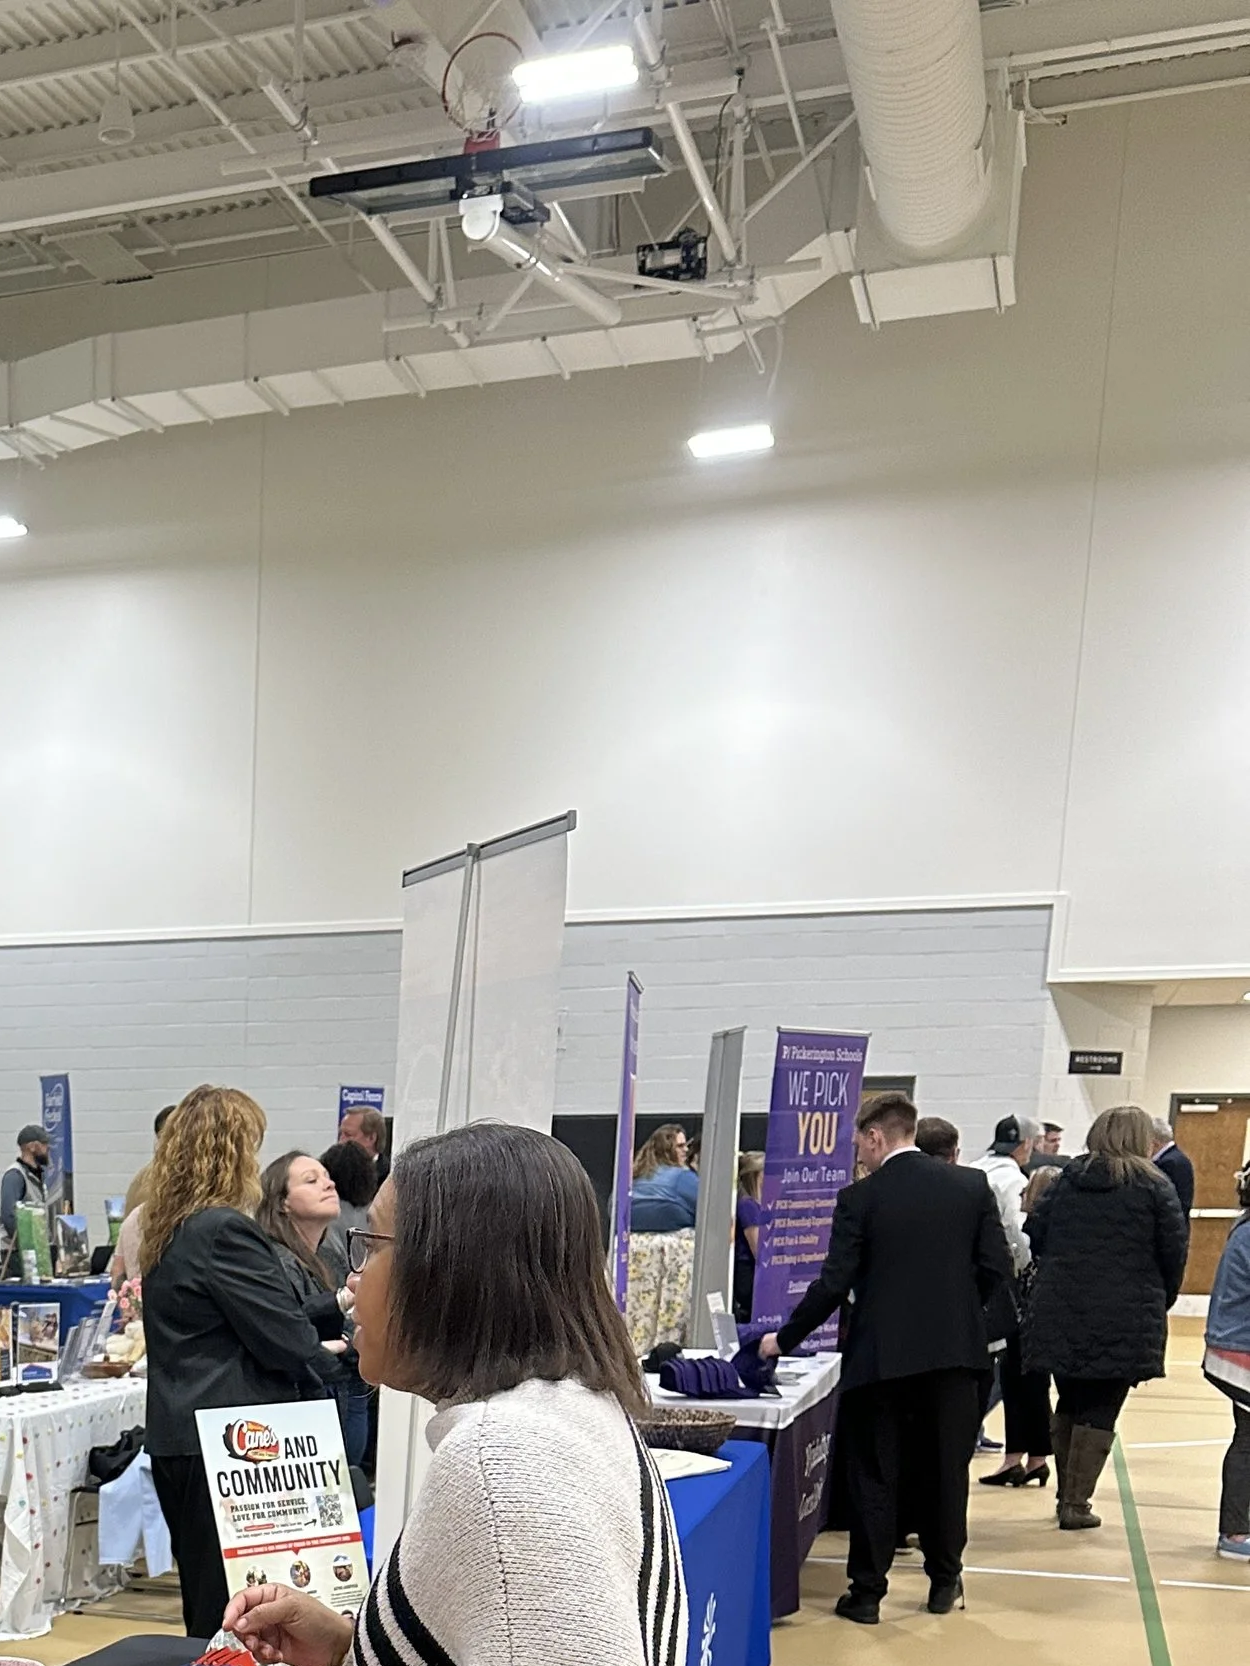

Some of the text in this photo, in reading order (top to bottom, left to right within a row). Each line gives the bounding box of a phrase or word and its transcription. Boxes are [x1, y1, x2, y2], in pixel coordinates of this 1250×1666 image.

[791, 1046, 836, 1063] Pickerington
[836, 1048, 864, 1062] Schools
[788, 1071, 851, 1106] WE PICK
[798, 1111, 839, 1156] YOU
[780, 1166, 847, 1184] Join Our Team
[284, 1435, 318, 1460] AND
[216, 1459, 341, 1498] COMMUNITY
[230, 1503, 260, 1514] PASSION
[262, 1501, 276, 1510] FOR
[232, 1506, 309, 1523] LOVE FOR COMMUNITY
